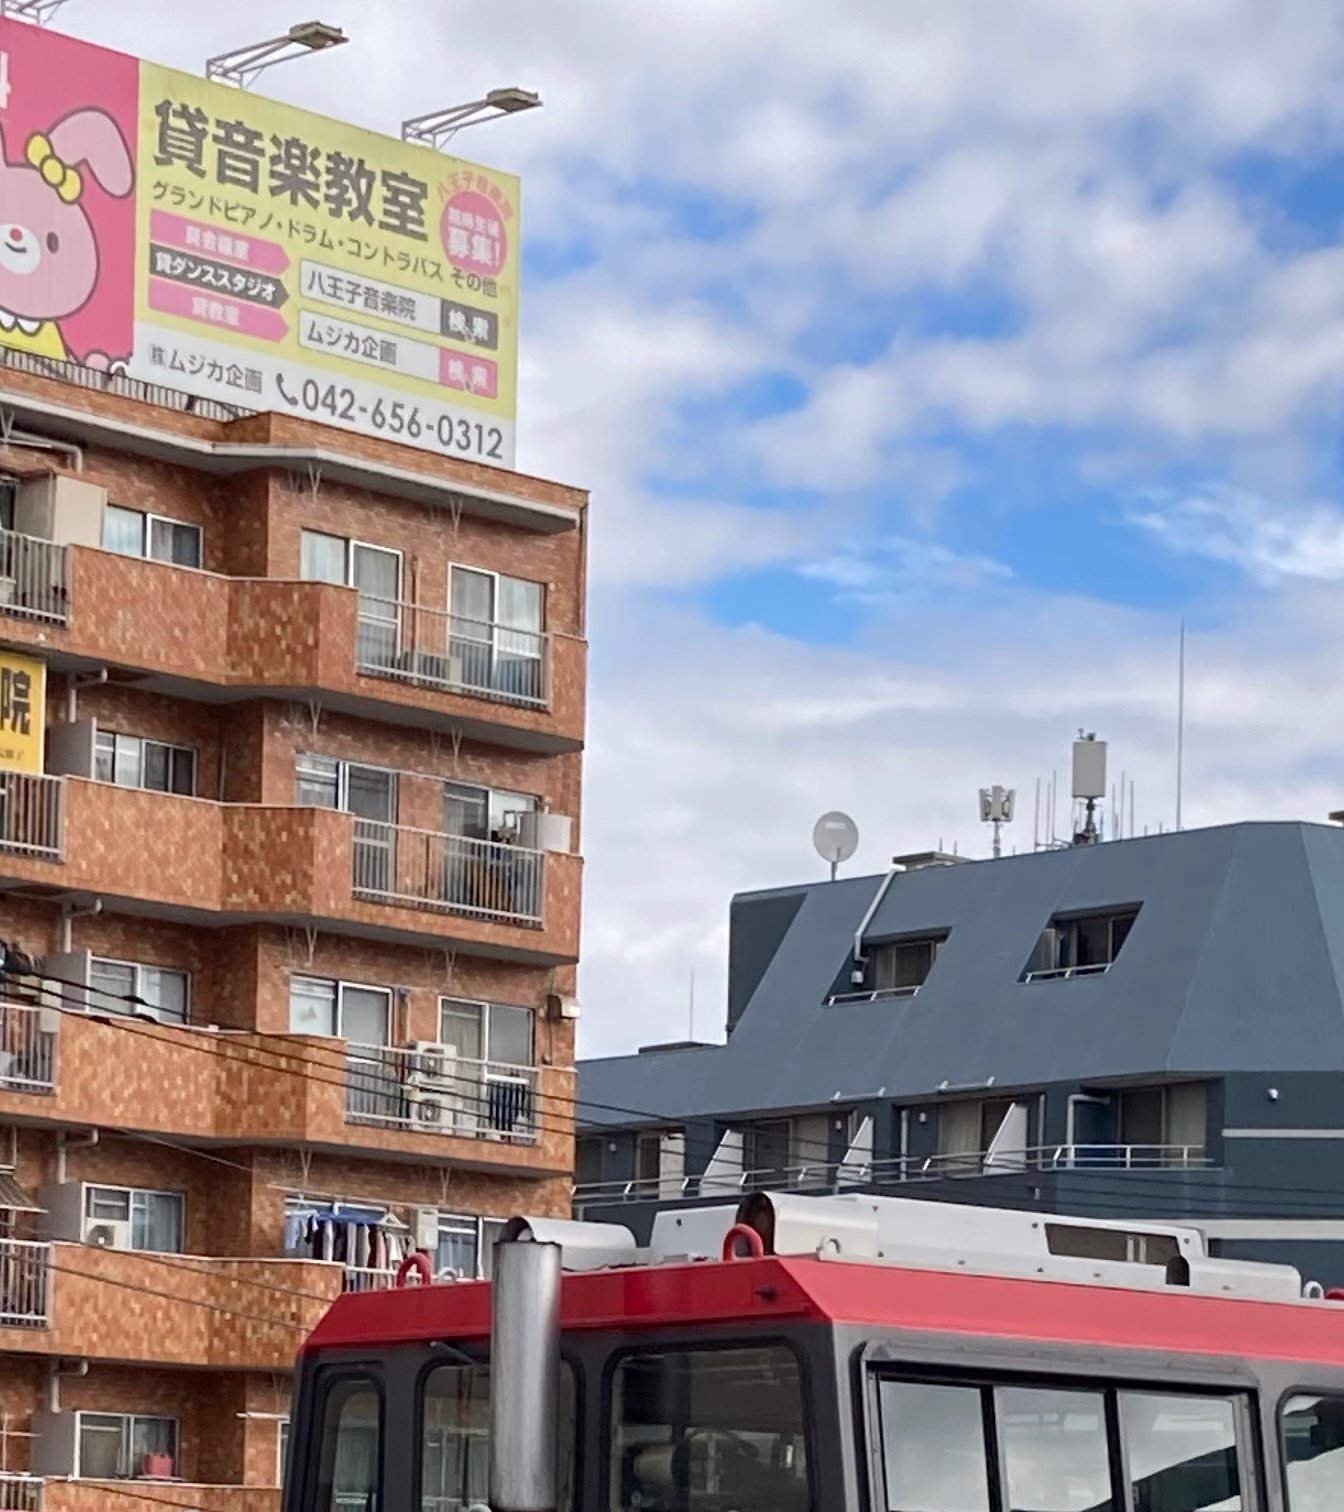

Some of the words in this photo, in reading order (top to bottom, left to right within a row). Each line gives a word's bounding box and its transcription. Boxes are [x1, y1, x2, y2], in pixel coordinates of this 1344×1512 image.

[153, 98, 429, 243] 貸音楽教室
[155, 251, 276, 302] 貸ダンススタジオ
[307, 269, 417, 321] 八王子音楽院
[307, 320, 398, 365] ムジカ企画
[448, 308, 489, 341] 検索
[302, 378, 504, 459] 042-656-0312
